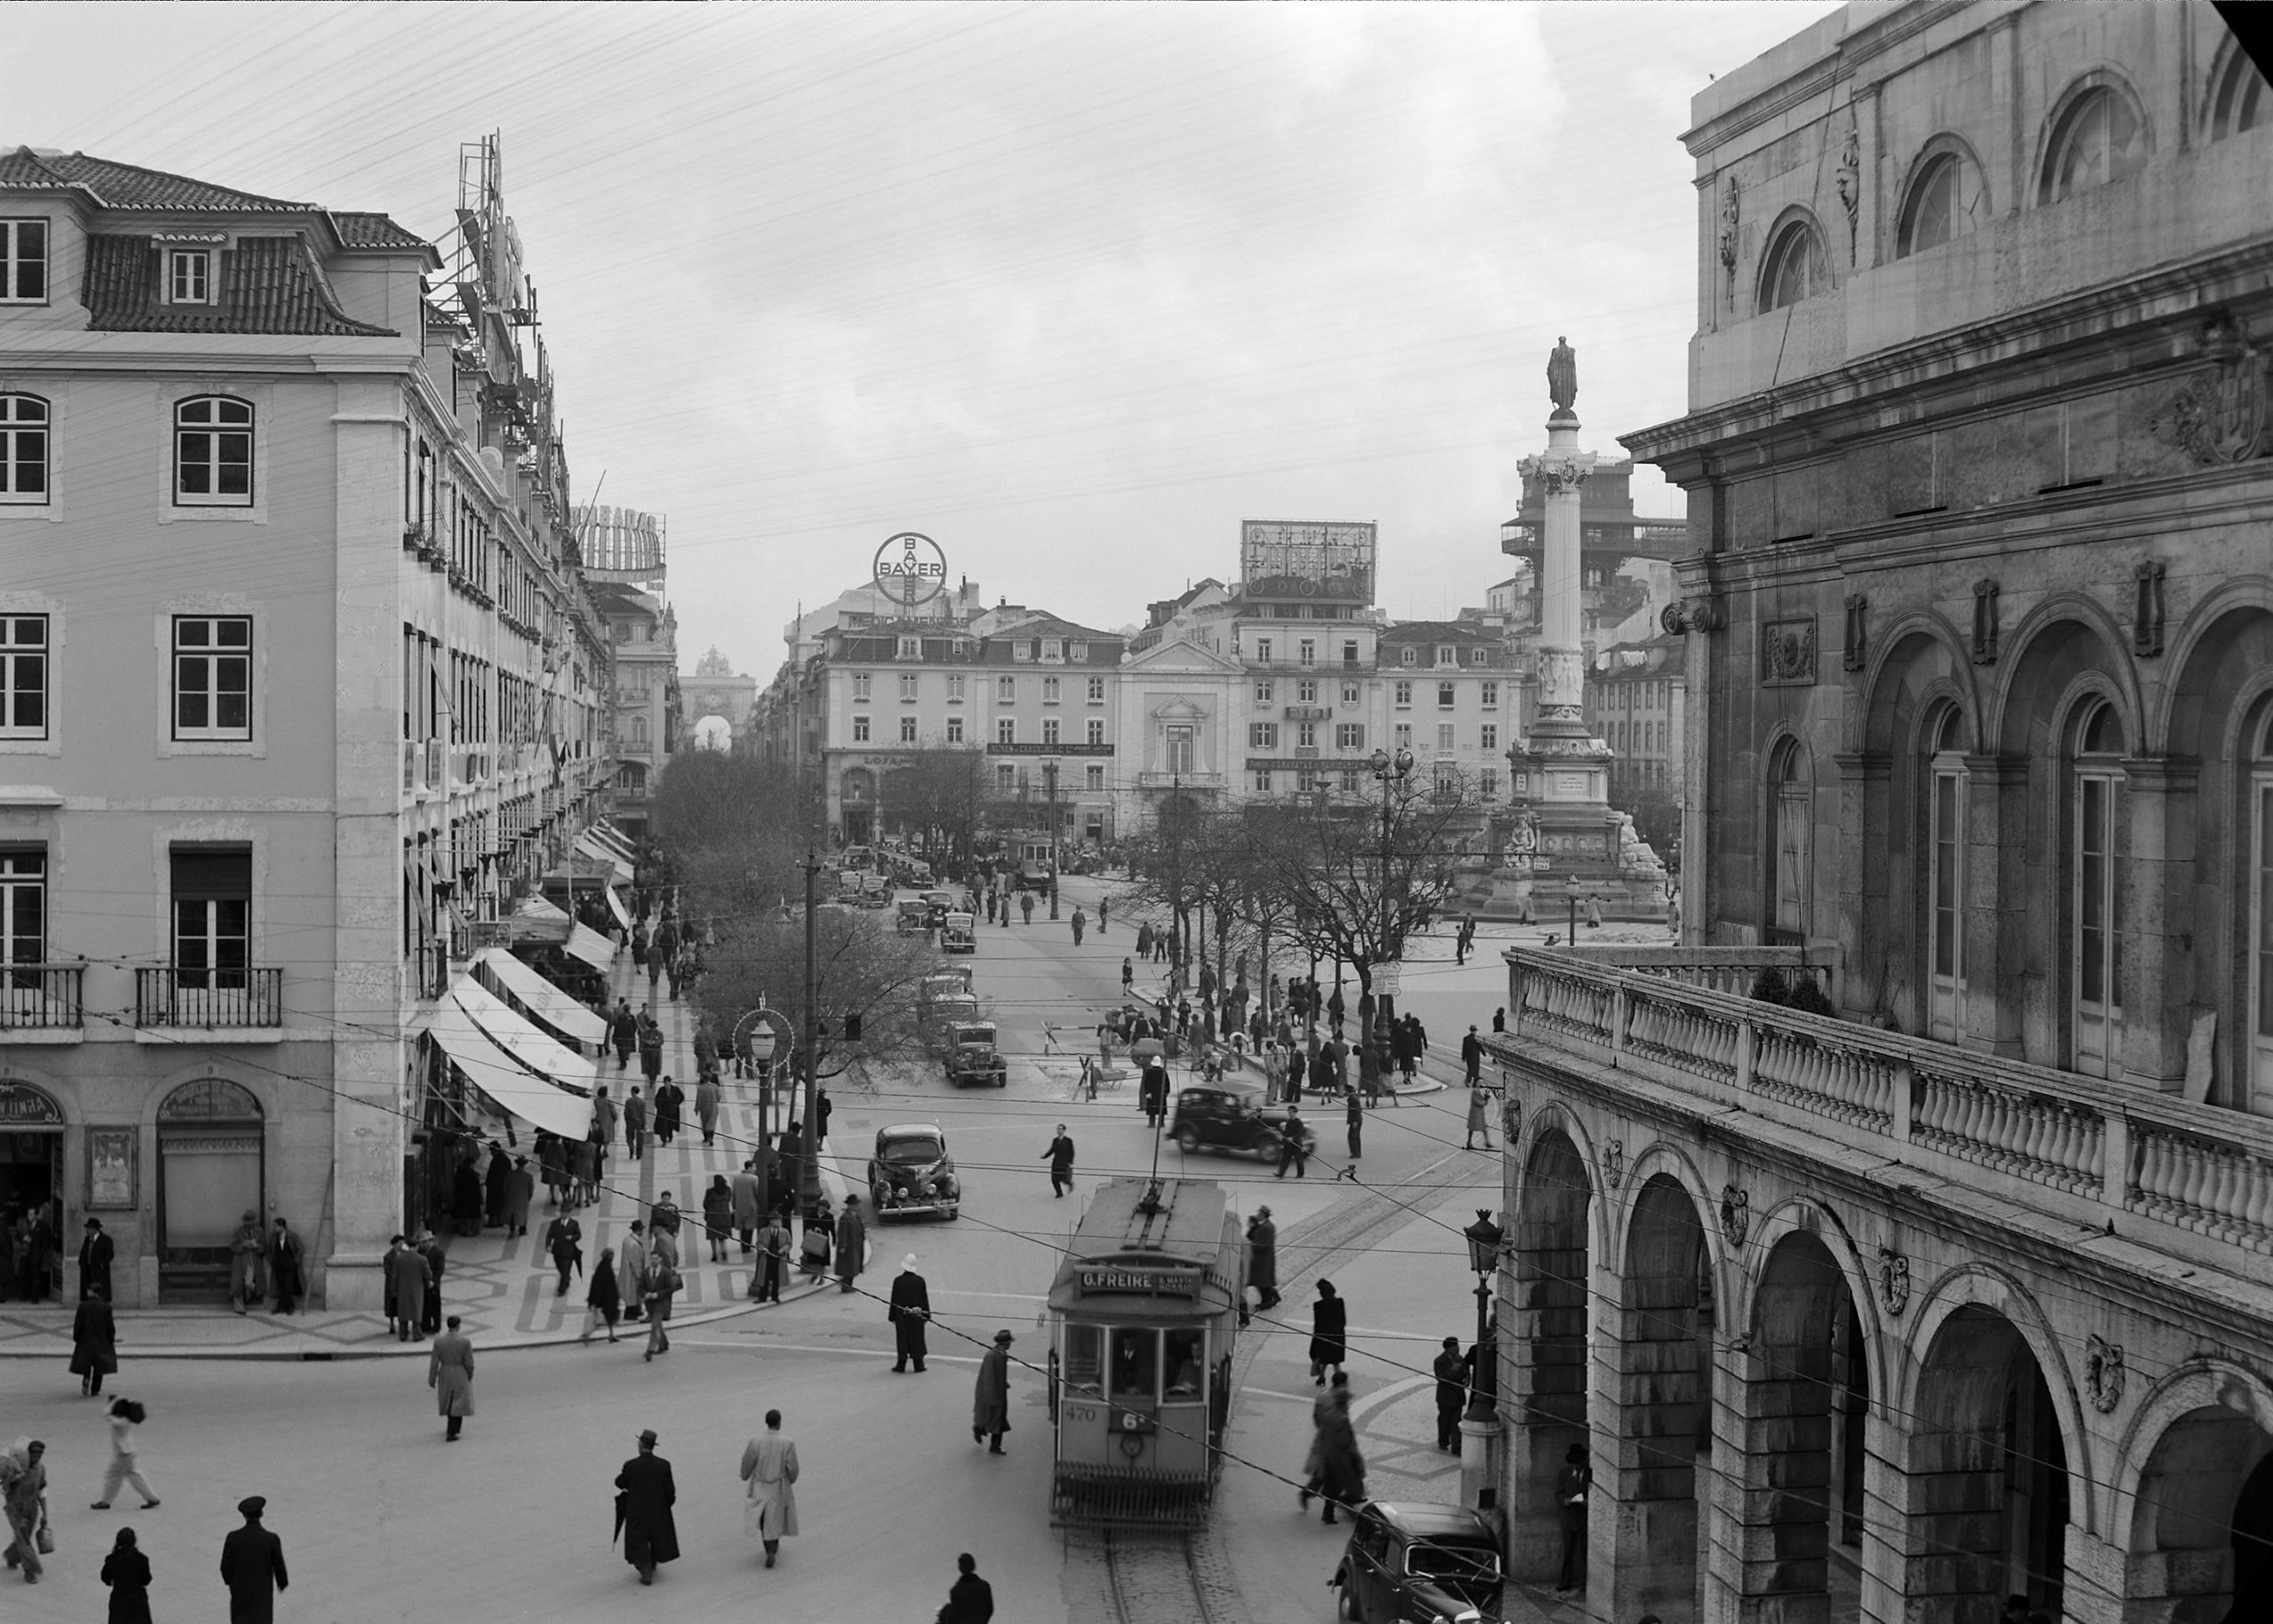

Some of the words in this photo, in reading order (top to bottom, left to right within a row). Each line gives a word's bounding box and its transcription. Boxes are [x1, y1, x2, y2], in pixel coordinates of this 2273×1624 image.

[880, 563, 941, 575] BAYER
[904, 538, 916, 604] BAYER
[1065, 1406, 1097, 1422] 470
